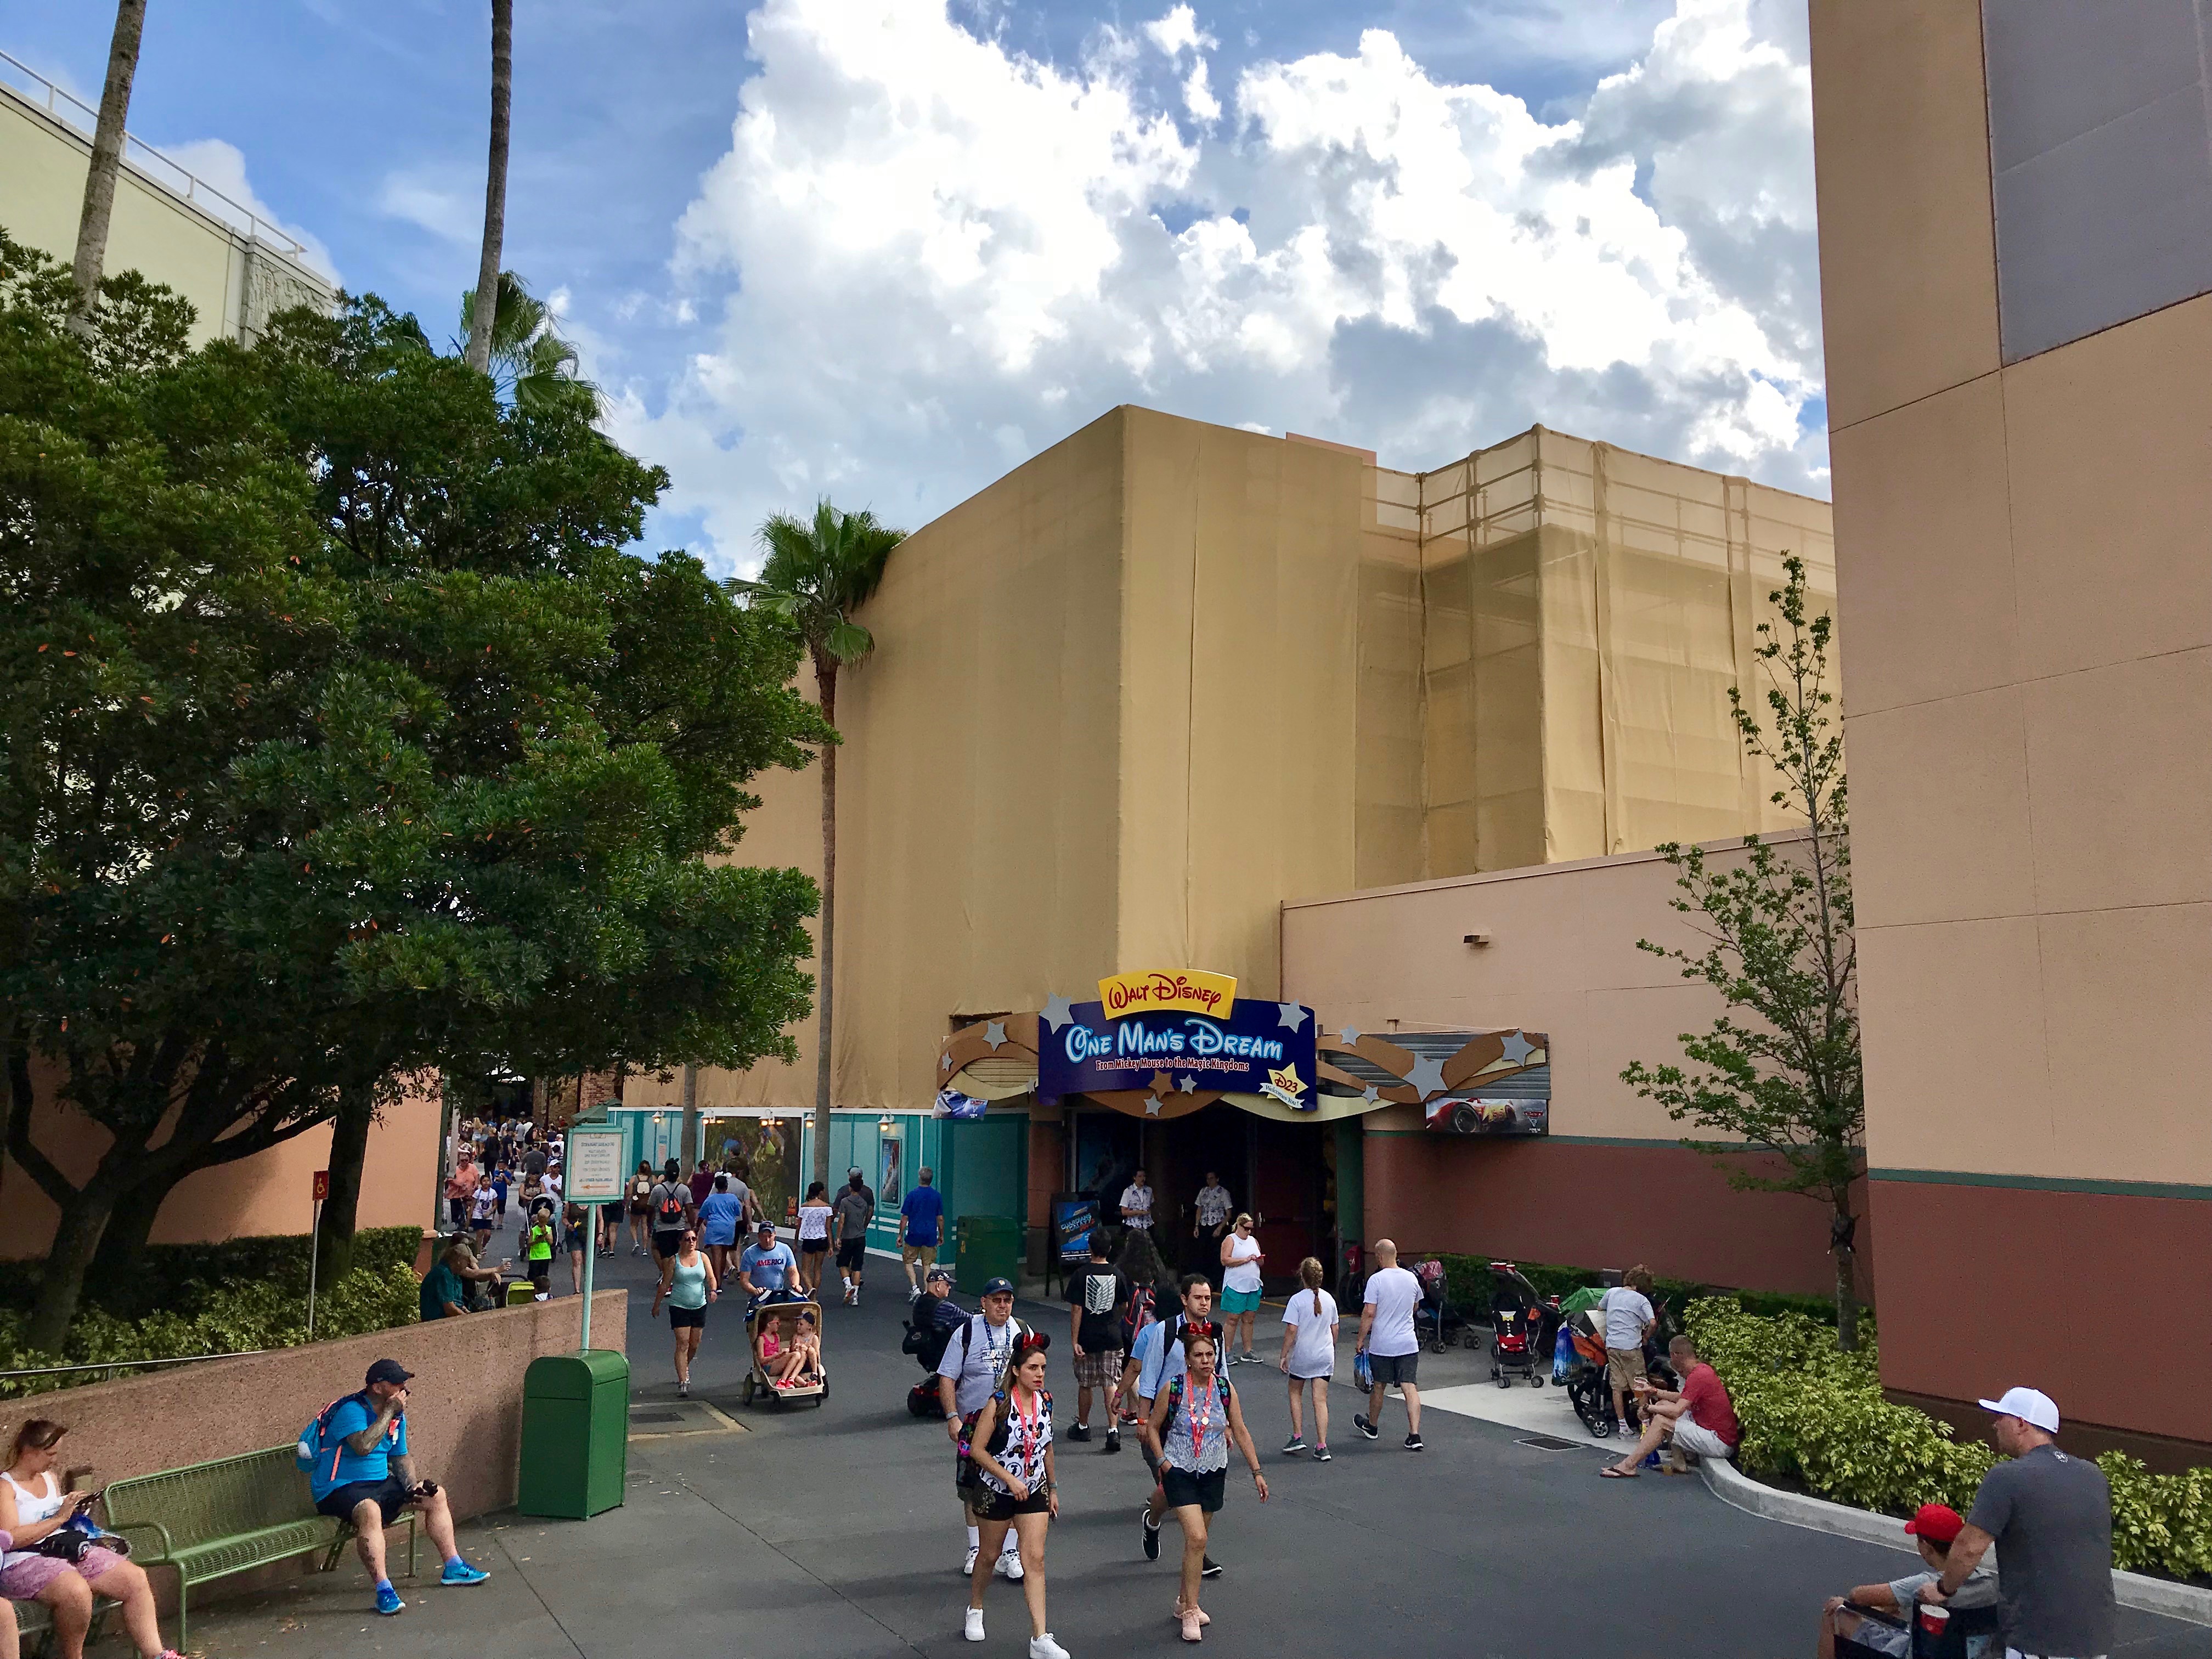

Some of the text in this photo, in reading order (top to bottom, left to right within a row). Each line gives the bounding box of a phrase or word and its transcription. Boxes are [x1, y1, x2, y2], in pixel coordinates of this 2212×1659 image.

[1096, 1056, 1249, 1073] From Mickey Mouse to the Magic Kingdoms
[1274, 1072, 1298, 1093] D23
[1265, 1085, 1287, 1101] Welcomes
[757, 1259, 784, 1267] AMERICA
